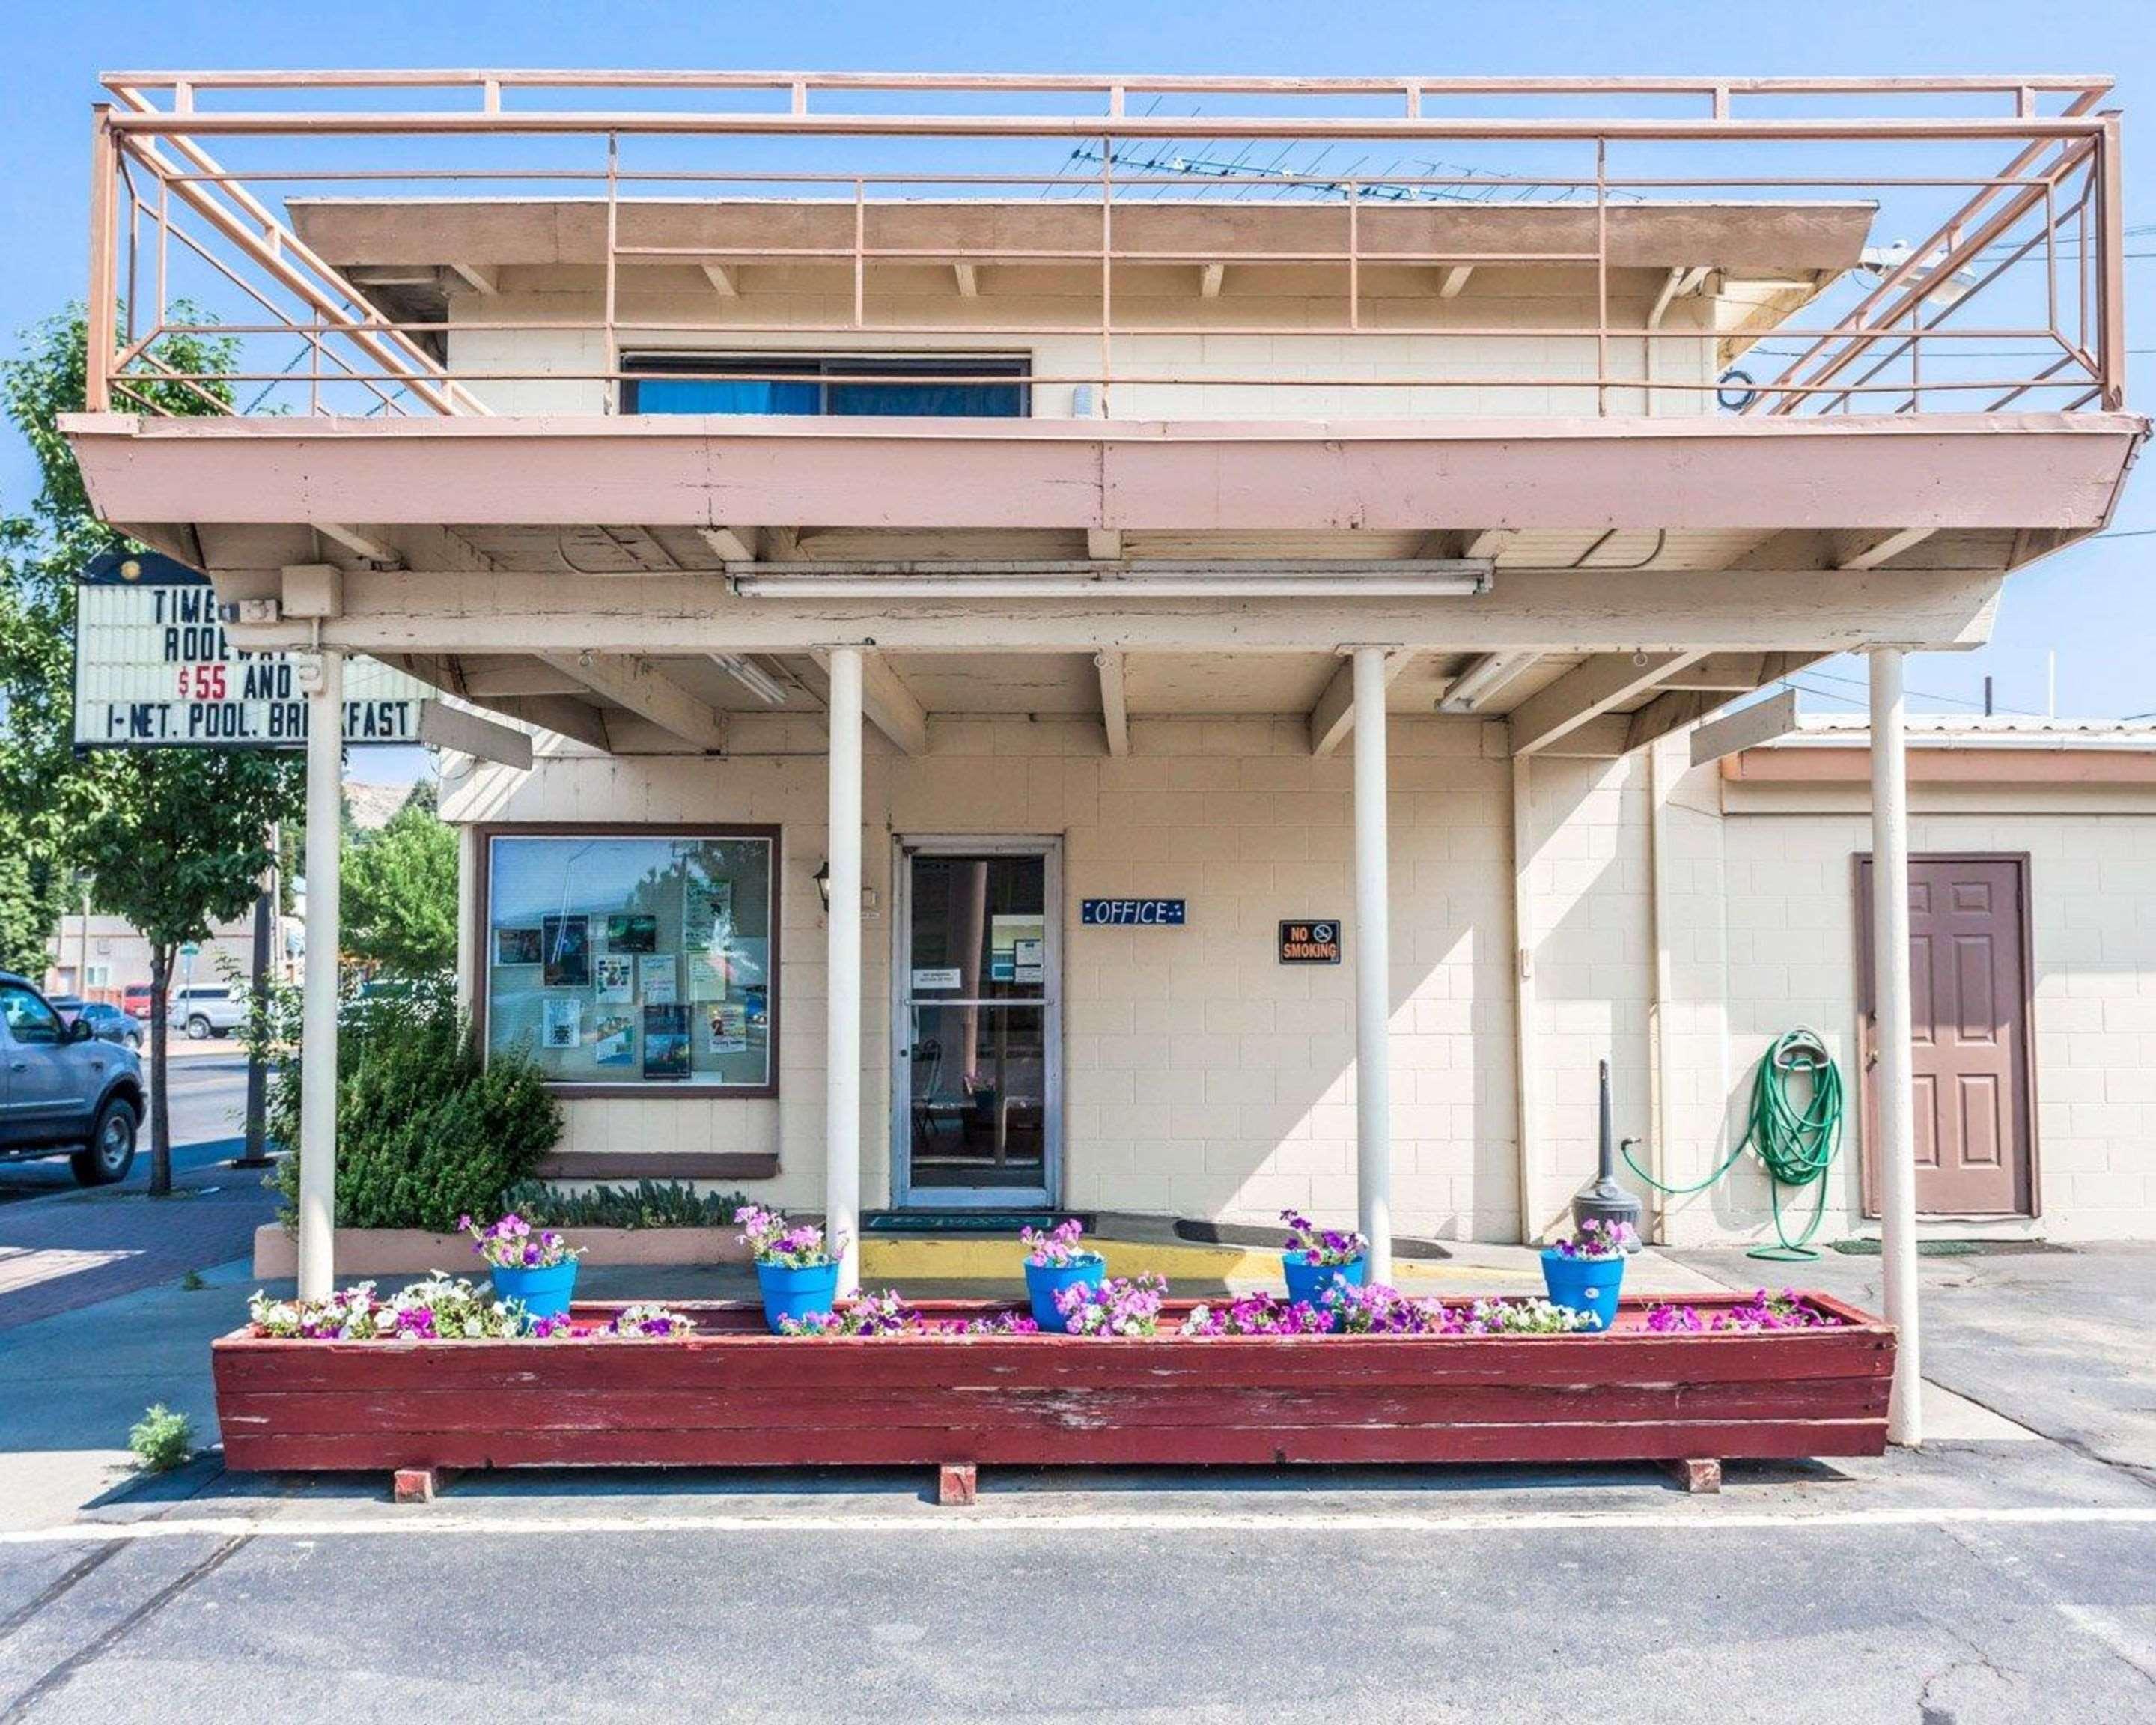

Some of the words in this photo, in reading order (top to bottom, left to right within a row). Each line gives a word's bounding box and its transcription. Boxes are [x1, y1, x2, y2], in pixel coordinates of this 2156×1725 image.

[179, 665, 226, 699] $55
[243, 664, 291, 699] AND
[1095, 901, 1168, 923] OFFICE
[1291, 926, 1308, 942] NO
[1283, 943, 1336, 958] SMOKING
